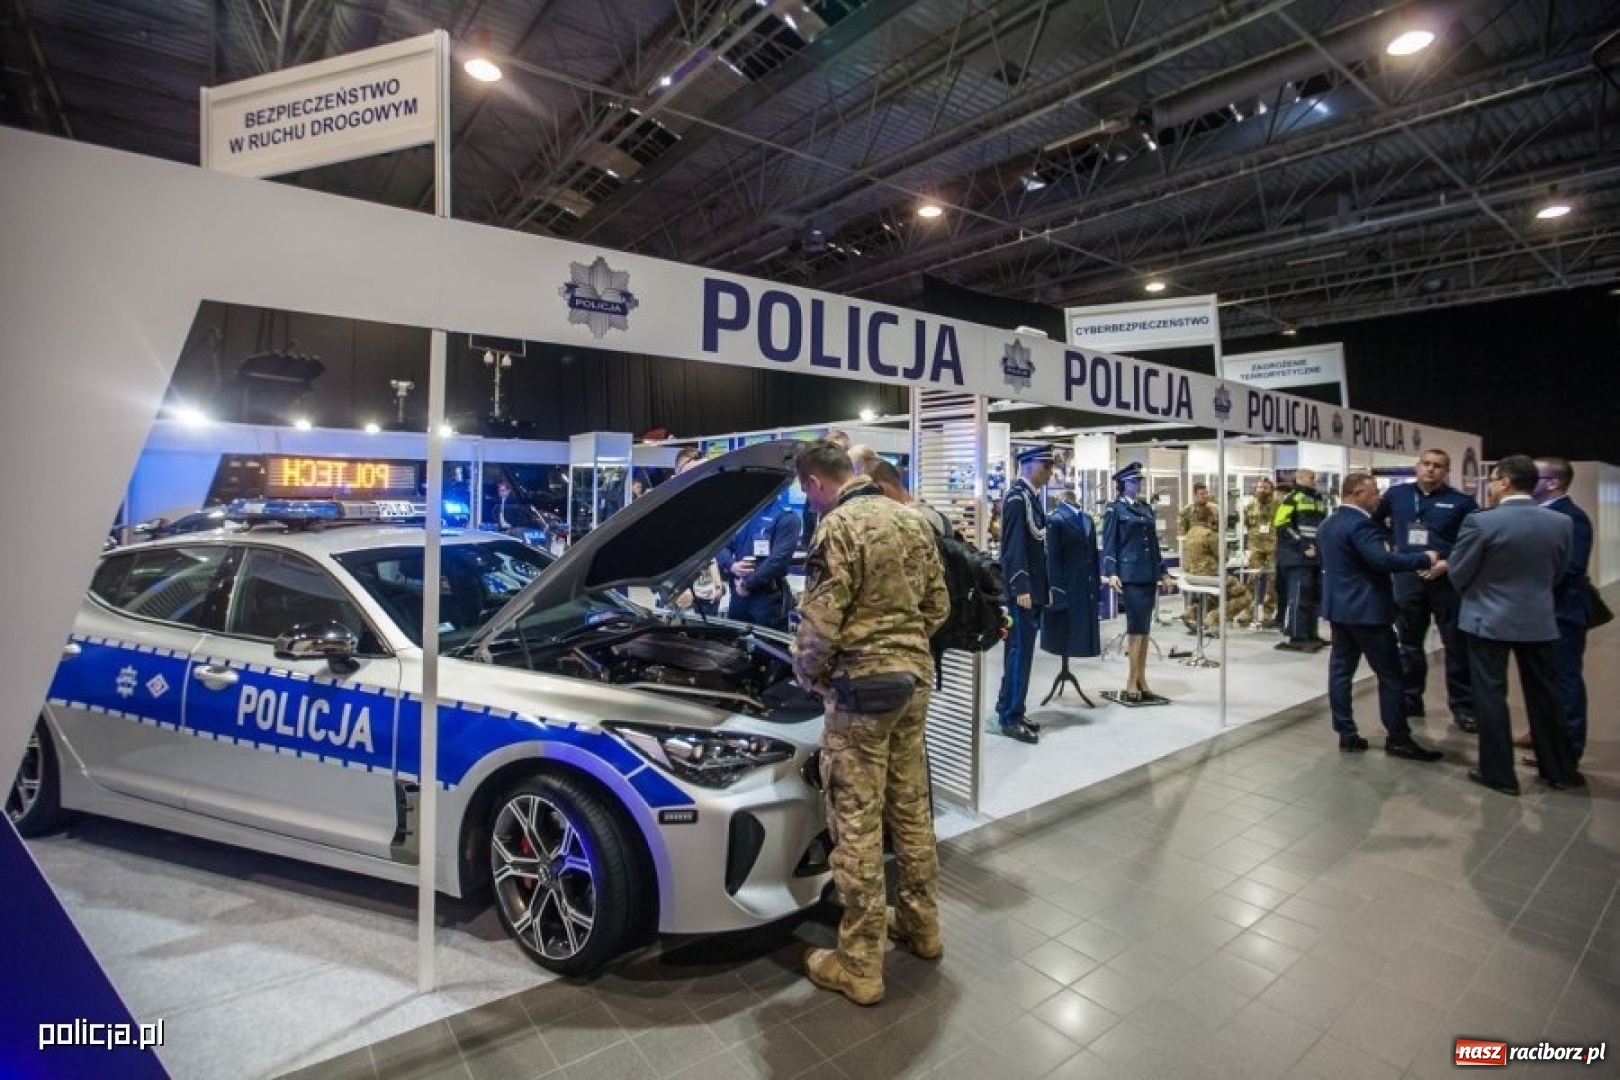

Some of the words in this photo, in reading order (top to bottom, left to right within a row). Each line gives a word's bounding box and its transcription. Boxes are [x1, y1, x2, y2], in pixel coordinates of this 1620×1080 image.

[228, 137, 244, 154] W
[249, 123, 305, 150] RUCHU
[310, 97, 419, 137] DROGOWYM
[244, 78, 400, 128] BEZPIECZEŃSTWO
[702, 276, 965, 385] POLICJA
[1075, 316, 1210, 336] CYBERBEZPIECZEŃSTWO
[1064, 349, 1193, 420] POLICJA
[1247, 389, 1320, 440] POLICJA
[1353, 413, 1405, 450] POLICJA
[236, 685, 374, 753] POLICJA
